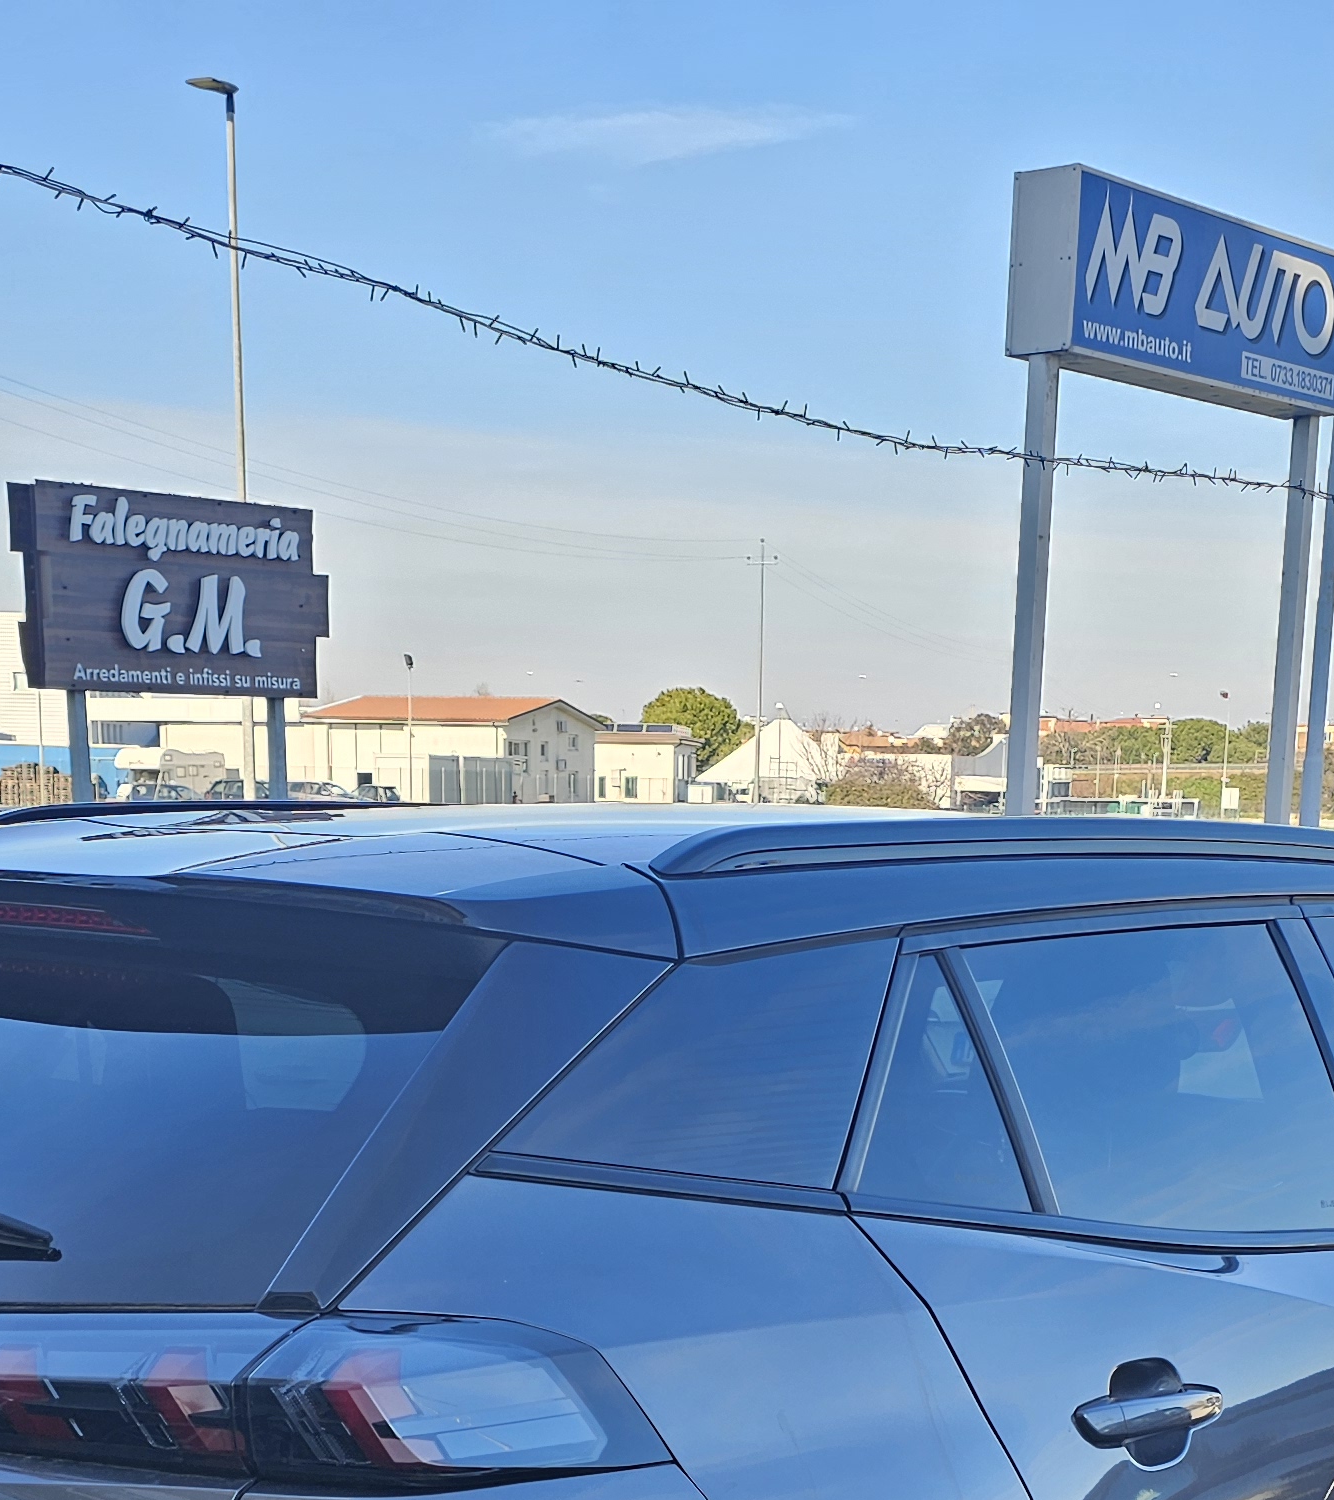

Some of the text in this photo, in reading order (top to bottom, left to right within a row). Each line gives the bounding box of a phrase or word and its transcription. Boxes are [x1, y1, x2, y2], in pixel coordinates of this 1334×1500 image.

[1085, 182, 1183, 317] MB
[1082, 319, 1192, 363] www.mbauto.it
[1244, 356, 1333, 396] TEL. 0733.1830371
[69, 494, 300, 561] Falegnameria
[121, 568, 262, 658] G.M.
[73, 663, 301, 690] Arredamenti e infissi su misura
